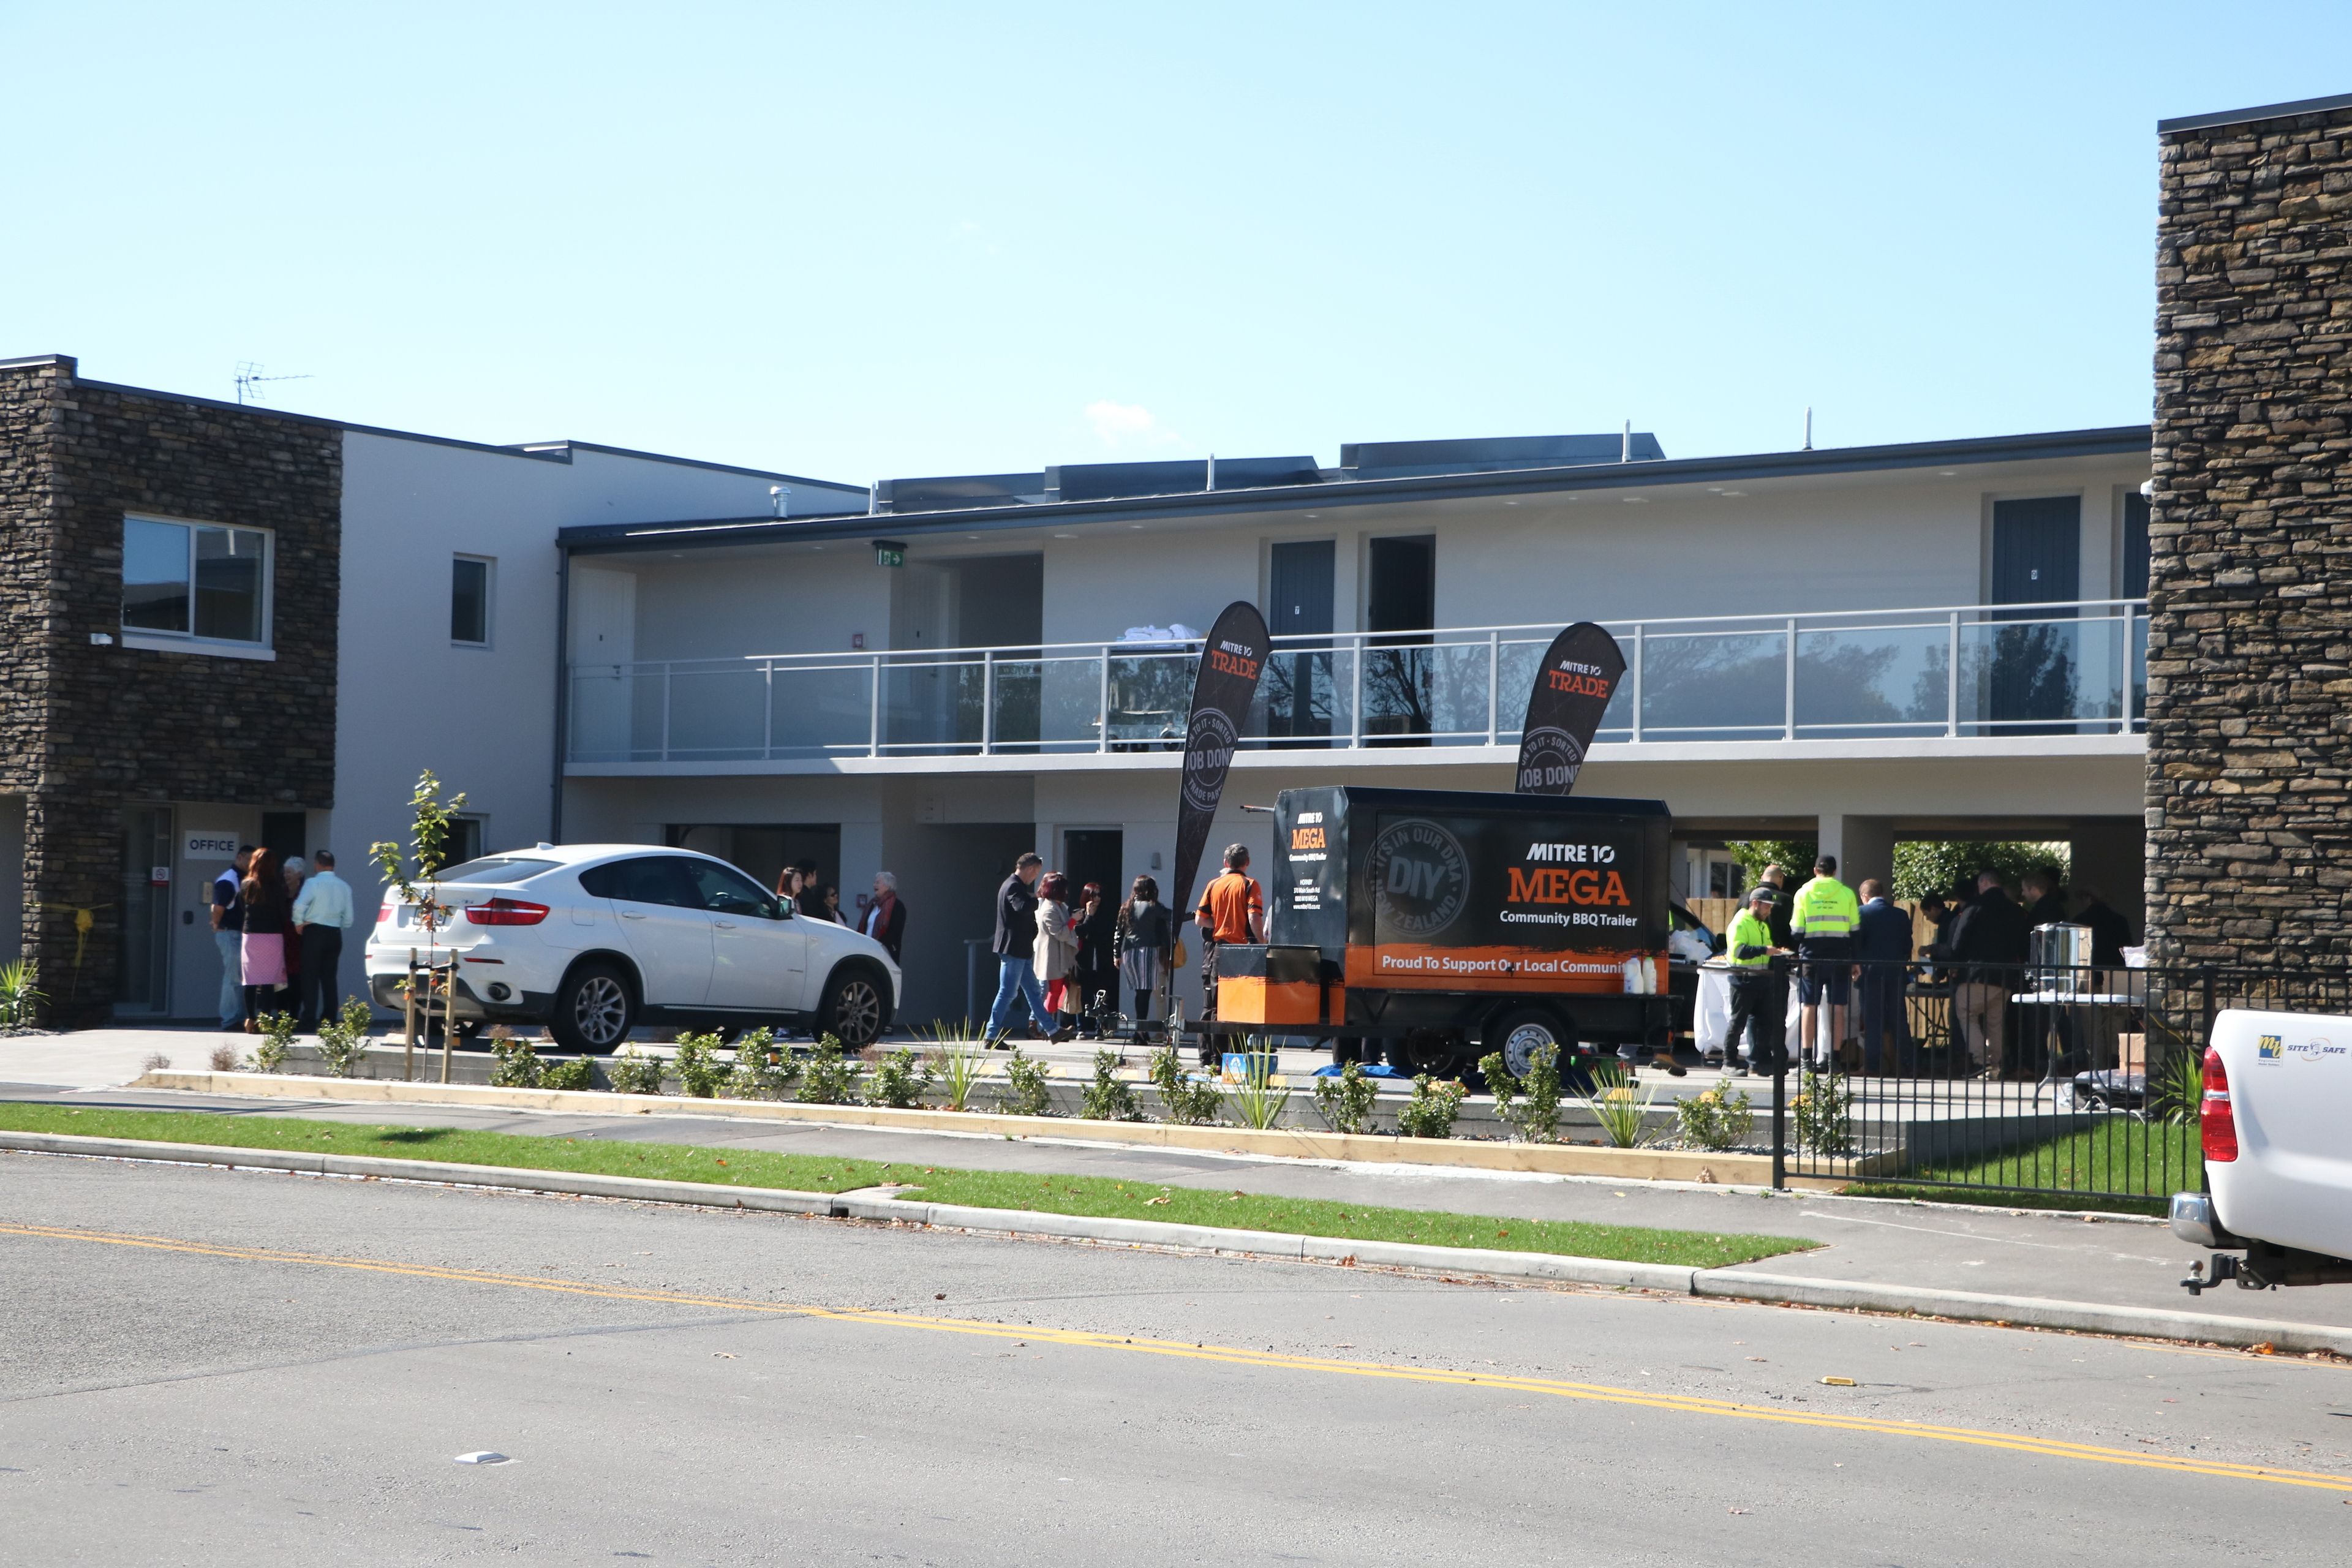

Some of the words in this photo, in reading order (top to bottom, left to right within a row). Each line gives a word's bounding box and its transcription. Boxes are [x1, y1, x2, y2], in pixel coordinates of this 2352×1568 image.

[1220, 640, 1242, 655] MITRE
[1243, 646, 1253, 657] 10
[1212, 650, 1257, 680] TRADE
[1559, 660, 1588, 674] MITRE
[1590, 665, 1602, 676] 10
[1548, 669, 1609, 699] TRADE
[1193, 723, 1200, 736] TO
[1201, 718, 1208, 729] IT
[1212, 718, 1232, 745] SORTED
[1526, 741, 1537, 753] TO
[1537, 736, 1545, 747] IT
[1551, 736, 1577, 762] SORTED
[1188, 777, 1206, 801] TRADE
[1297, 812, 1315, 824] MITRE
[1315, 812, 1323, 823] 10
[190, 839, 235, 851] OFFICE
[1292, 827, 1326, 850] MEGA
[1391, 830, 1409, 848] IN
[1413, 827, 1444, 850] OUR
[1440, 845, 1462, 883] DNA
[1526, 843, 1587, 862] MITRE
[1591, 845, 1615, 864] 10
[1387, 855, 1447, 900] DIY
[1507, 867, 1631, 906] MEGA
[1370, 878, 1396, 915] NEW
[1393, 895, 1457, 930] ZEALAND
[1499, 910, 1570, 927] Community
[1572, 913, 1598, 927] BBQ
[1599, 914, 1637, 927] Trailer
[1382, 956, 1422, 969] Proud
[1424, 956, 1439, 969] To
[1442, 957, 1496, 973] Support
[1524, 959, 1558, 973] Local
